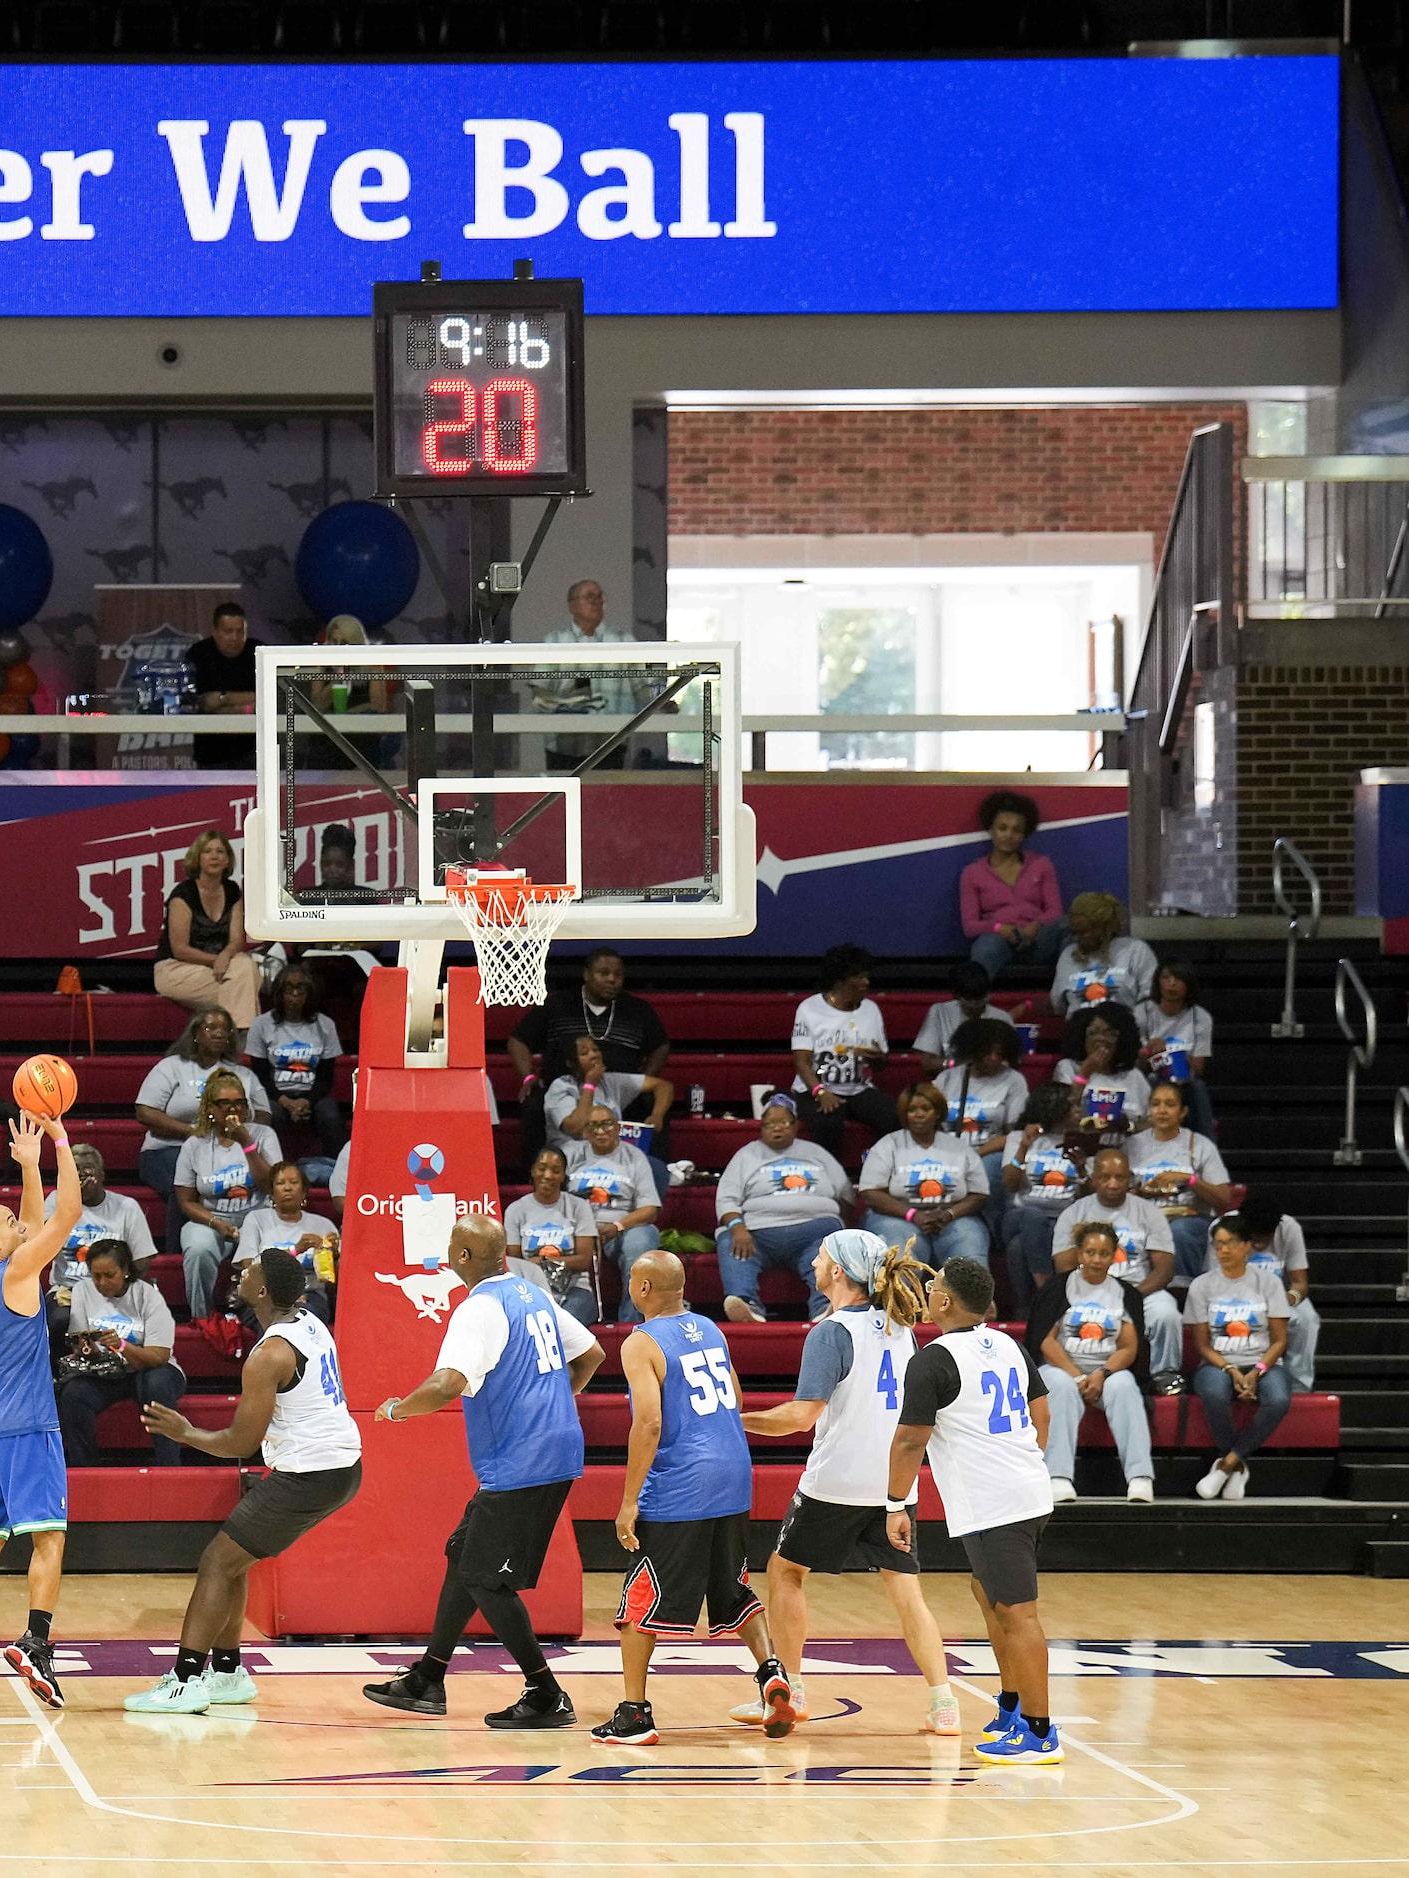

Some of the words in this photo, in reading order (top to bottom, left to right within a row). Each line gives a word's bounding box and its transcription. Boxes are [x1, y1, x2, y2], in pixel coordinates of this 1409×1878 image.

[158, 119, 411, 242] We
[463, 111, 777, 240] Ball
[439, 318, 551, 370] 9:16
[423, 379, 538, 474] 20
[100, 643, 189, 661] TOGET
[279, 908, 326, 921] SPALDING
[1092, 1092, 1118, 1104] SMU
[216, 1194, 259, 1213] BALL
[357, 1194, 403, 1223] Orig
[455, 1193, 497, 1217] ank
[526, 1309, 564, 1375] 18
[1064, 1336, 1118, 1354] BALL
[678, 1347, 738, 1416] 55
[877, 1349, 898, 1410] 4
[980, 1367, 1029, 1435] 24
